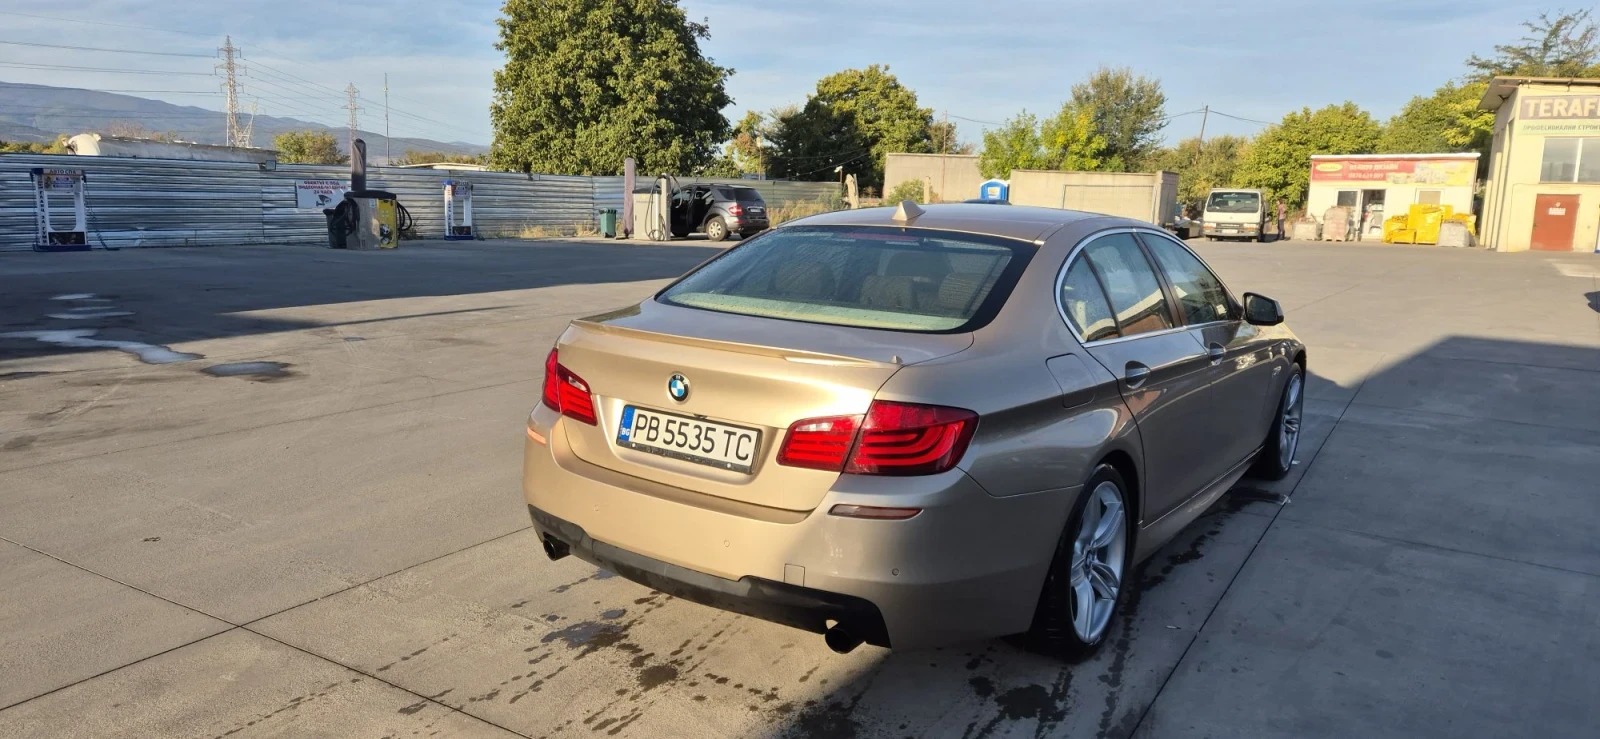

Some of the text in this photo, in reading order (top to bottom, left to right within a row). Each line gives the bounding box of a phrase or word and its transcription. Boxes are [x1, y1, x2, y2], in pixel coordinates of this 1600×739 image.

[633, 413, 660, 442] PB
[663, 419, 716, 453] 5535
[723, 430, 752, 461] TC
